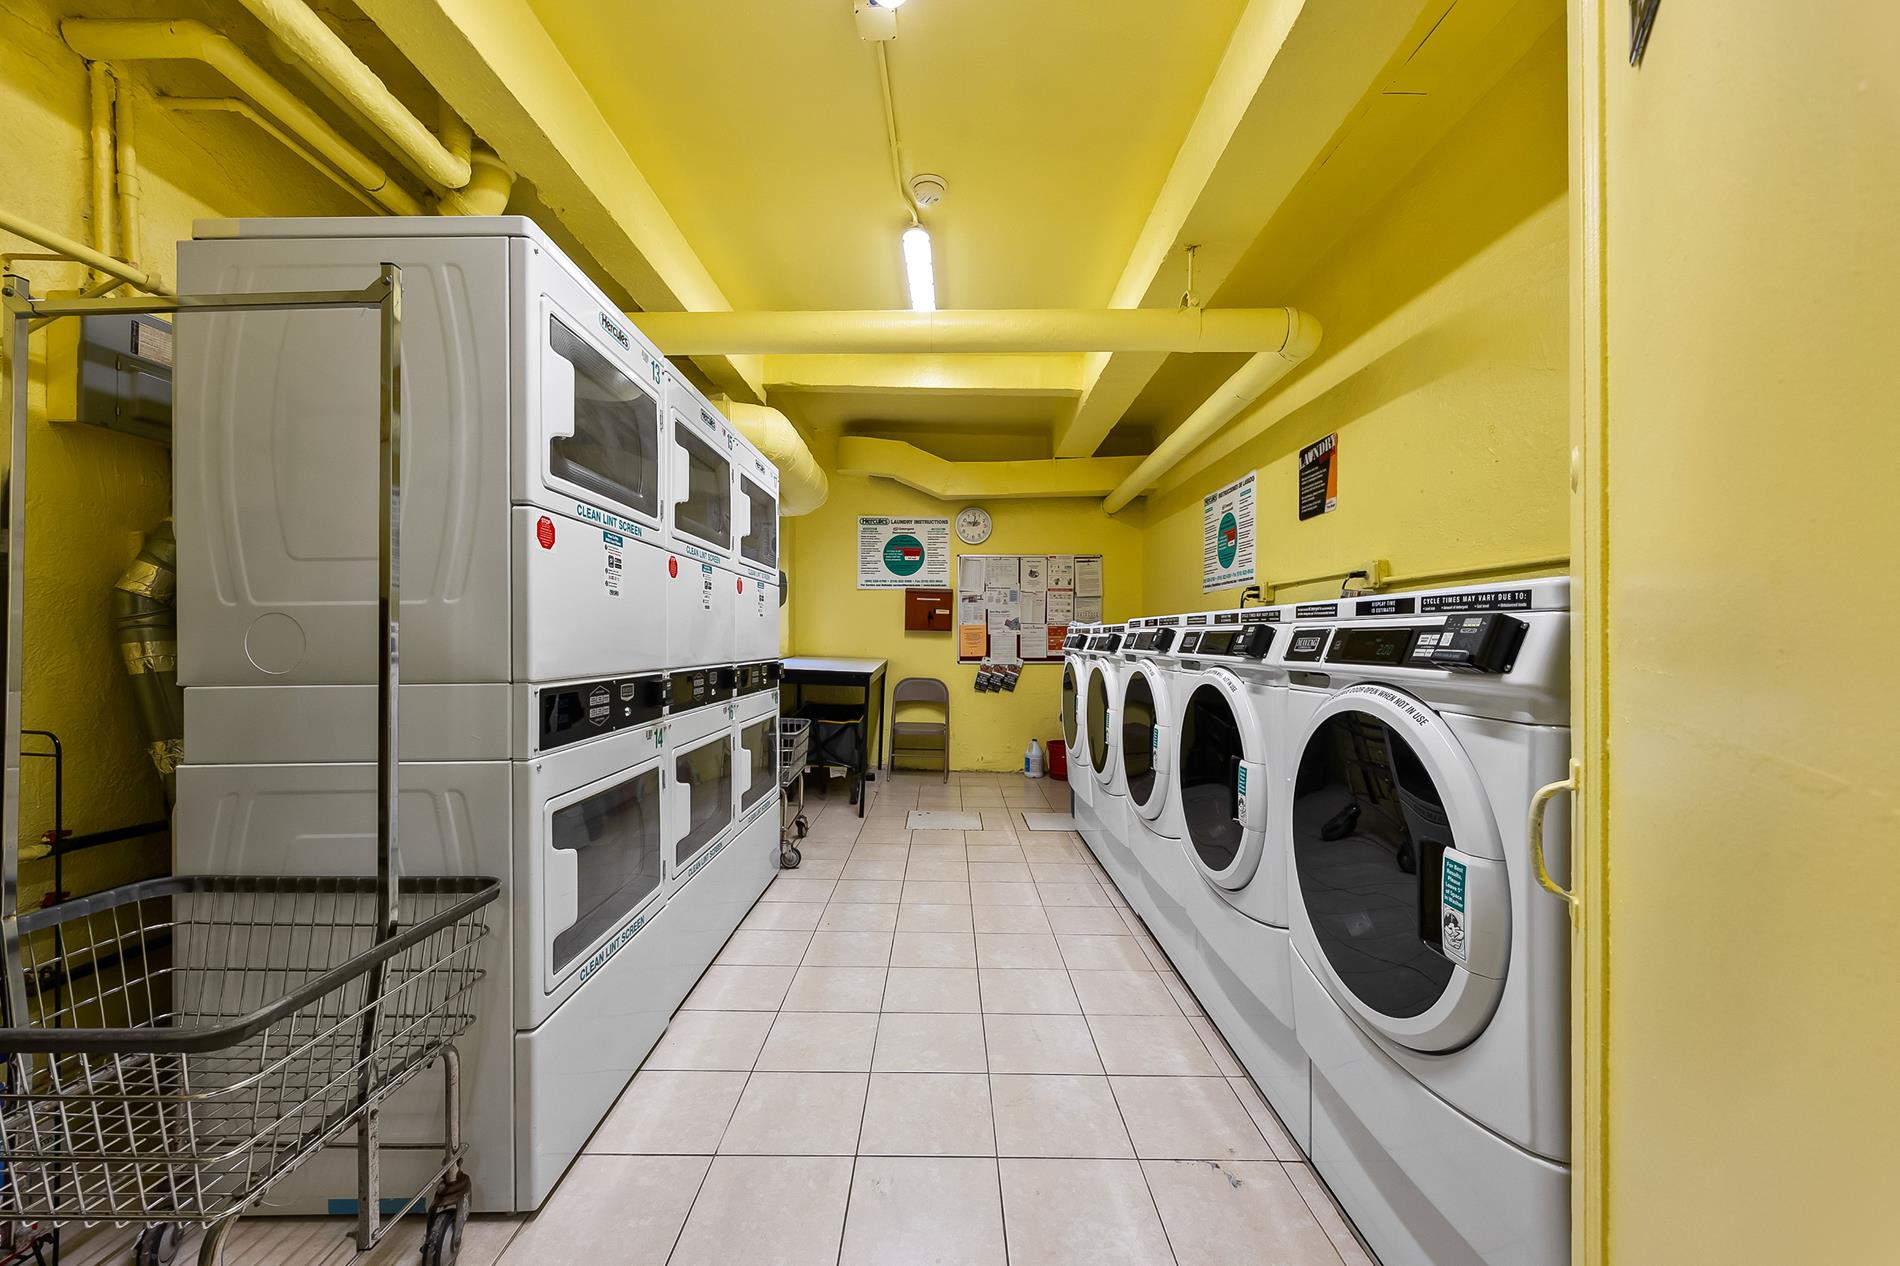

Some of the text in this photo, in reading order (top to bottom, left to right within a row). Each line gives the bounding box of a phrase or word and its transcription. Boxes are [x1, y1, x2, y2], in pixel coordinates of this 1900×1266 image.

[601, 312, 628, 348] Hercules
[651, 360, 660, 384] 13
[1300, 435, 1336, 470] LAUNDRY
[576, 504, 642, 537] CLEAN LINT SCREEN
[686, 546, 698, 556] CLEAN
[708, 553, 720, 564] SCREEN
[1363, 686, 1378, 695] OPEN
[1377, 690, 1395, 702] WHEN
[1393, 697, 1409, 710] NOT
[1405, 705, 1417, 715] IN
[1412, 712, 1430, 726] USE
[654, 728, 663, 749] 14
[580, 916, 645, 981] CLEAN LINT SCREEN
